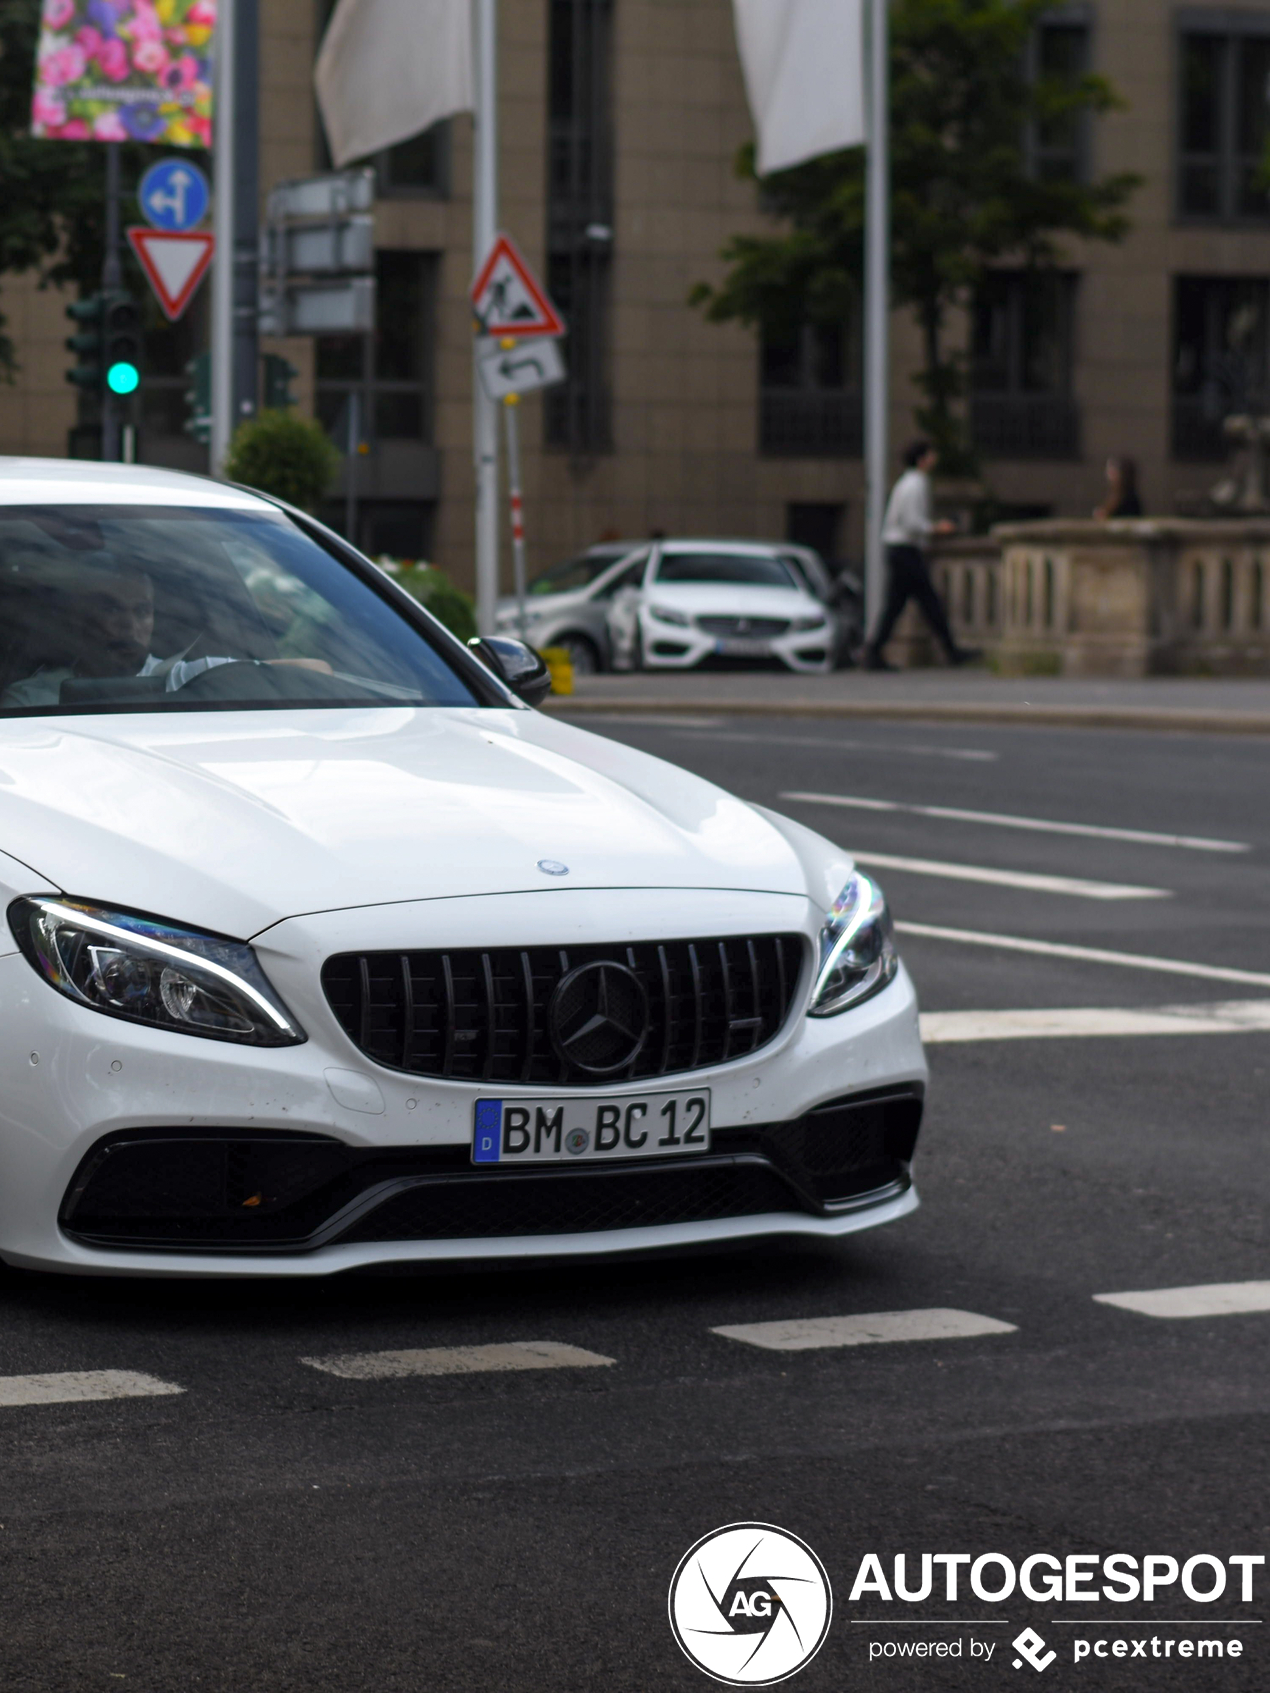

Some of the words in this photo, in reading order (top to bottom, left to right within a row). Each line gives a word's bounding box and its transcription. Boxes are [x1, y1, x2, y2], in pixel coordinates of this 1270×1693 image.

[482, 1137, 492, 1151] D
[502, 1106, 564, 1154] BM
[594, 1102, 648, 1151] BC
[658, 1097, 706, 1147] 12
